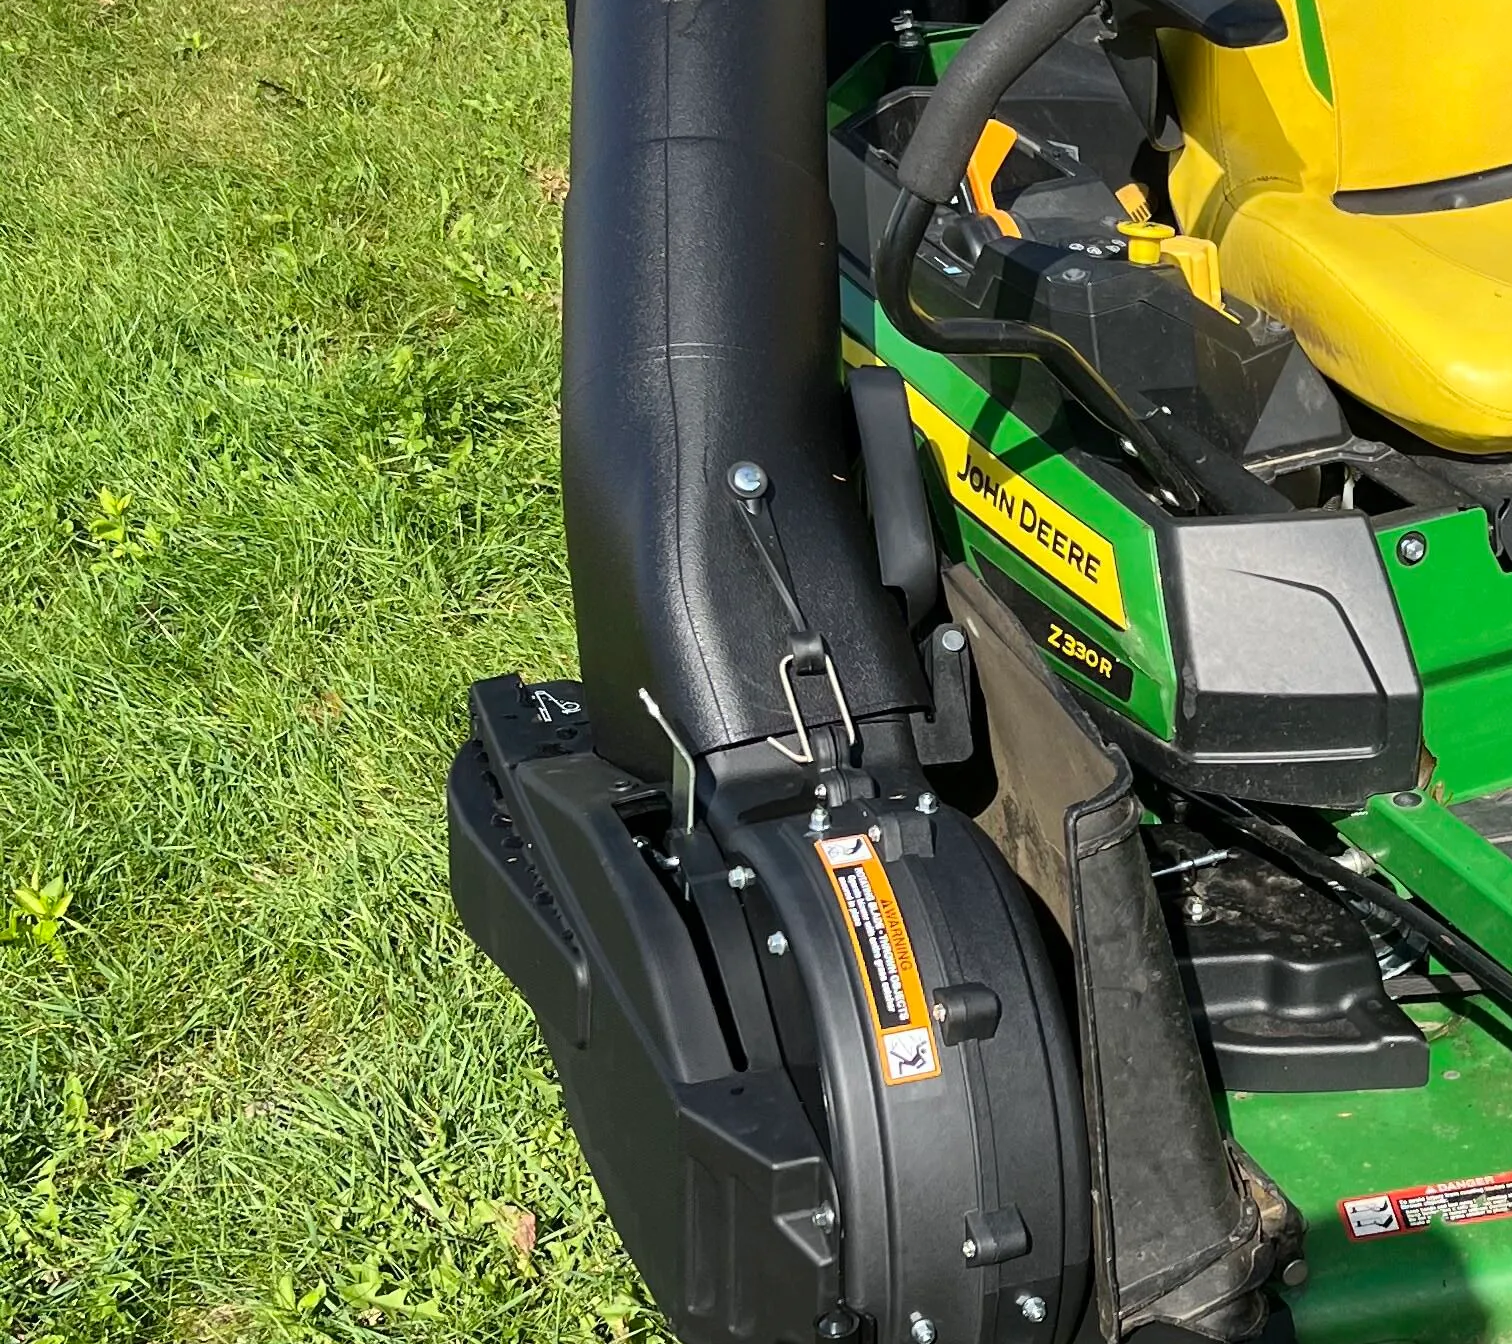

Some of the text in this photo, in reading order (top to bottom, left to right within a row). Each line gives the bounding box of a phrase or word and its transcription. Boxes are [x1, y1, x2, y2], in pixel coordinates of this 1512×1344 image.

[957, 454, 1101, 584] JOHN DEERE
[1047, 623, 1113, 679] Z330R
[884, 907, 913, 972] WARNING
[1438, 1175, 1495, 1192] DANGER
